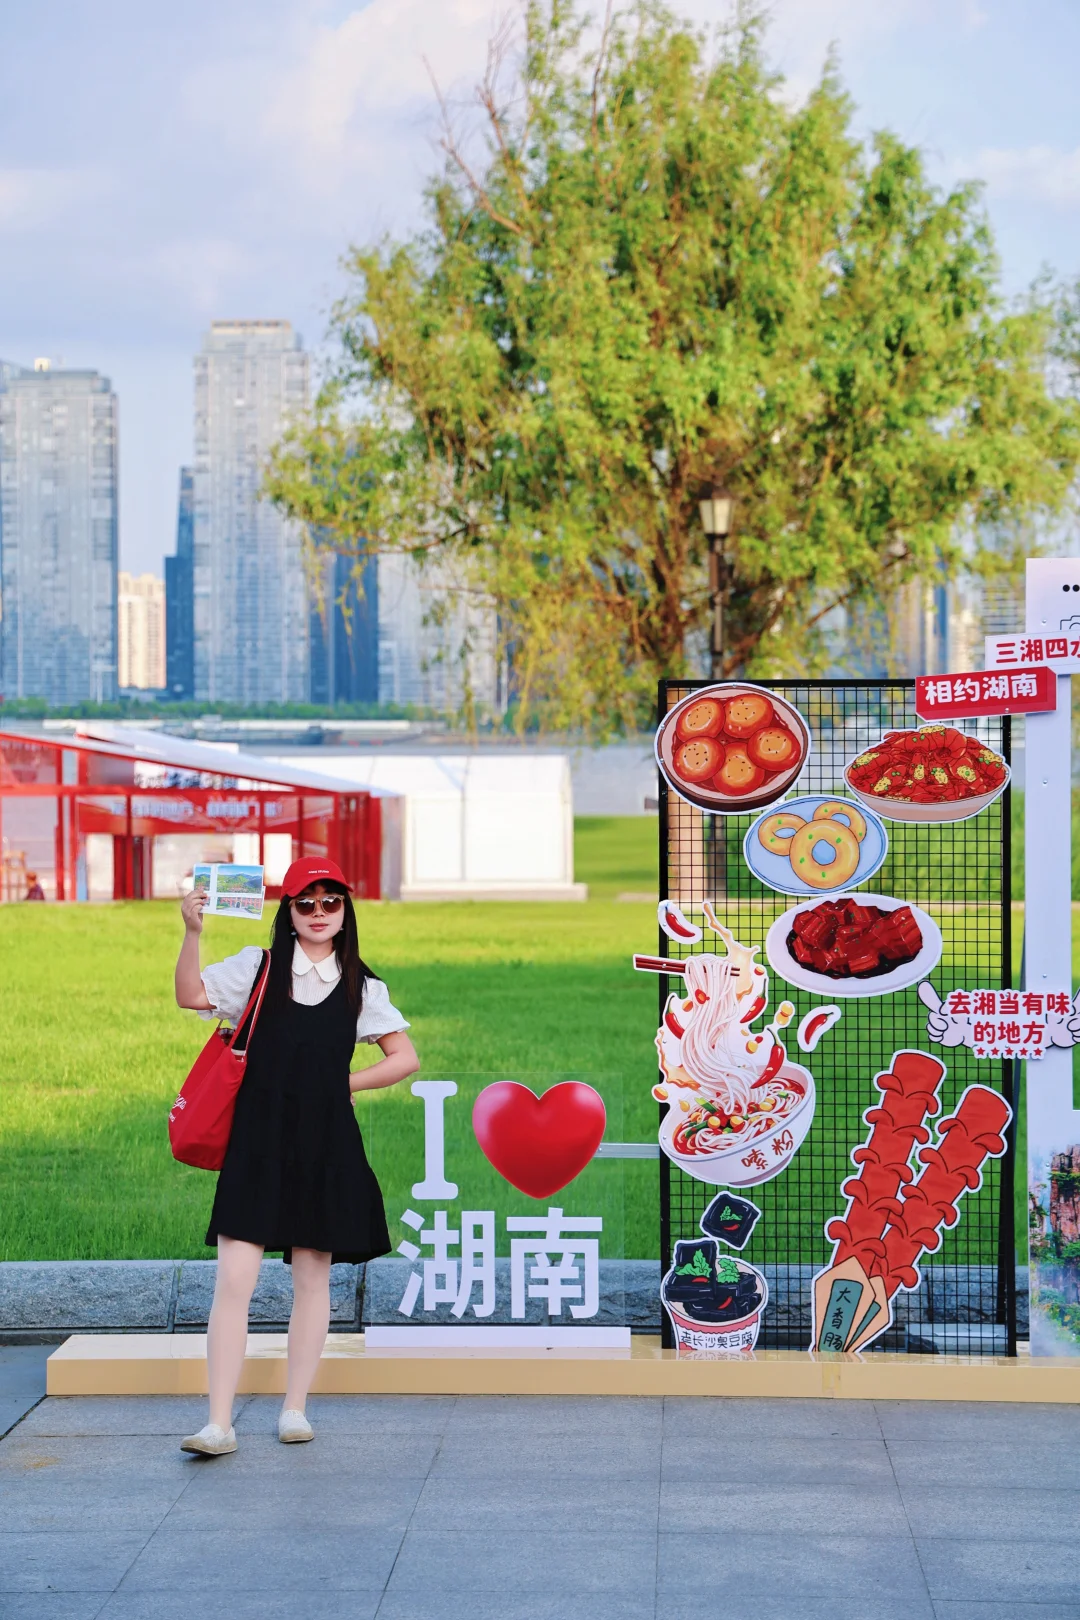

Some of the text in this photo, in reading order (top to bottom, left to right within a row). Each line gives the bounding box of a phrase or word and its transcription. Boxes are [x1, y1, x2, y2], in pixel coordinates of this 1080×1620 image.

[925, 673, 1038, 705] 相约湖南
[948, 992, 1070, 1015] 去湘当有味
[973, 1021, 1045, 1044] 的地方
[410, 1080, 458, 1200] I
[396, 1206, 603, 1319] 湖南
[823, 1287, 852, 1350] 大香肠
[681, 1330, 753, 1348] 老长沙臭豆腐
